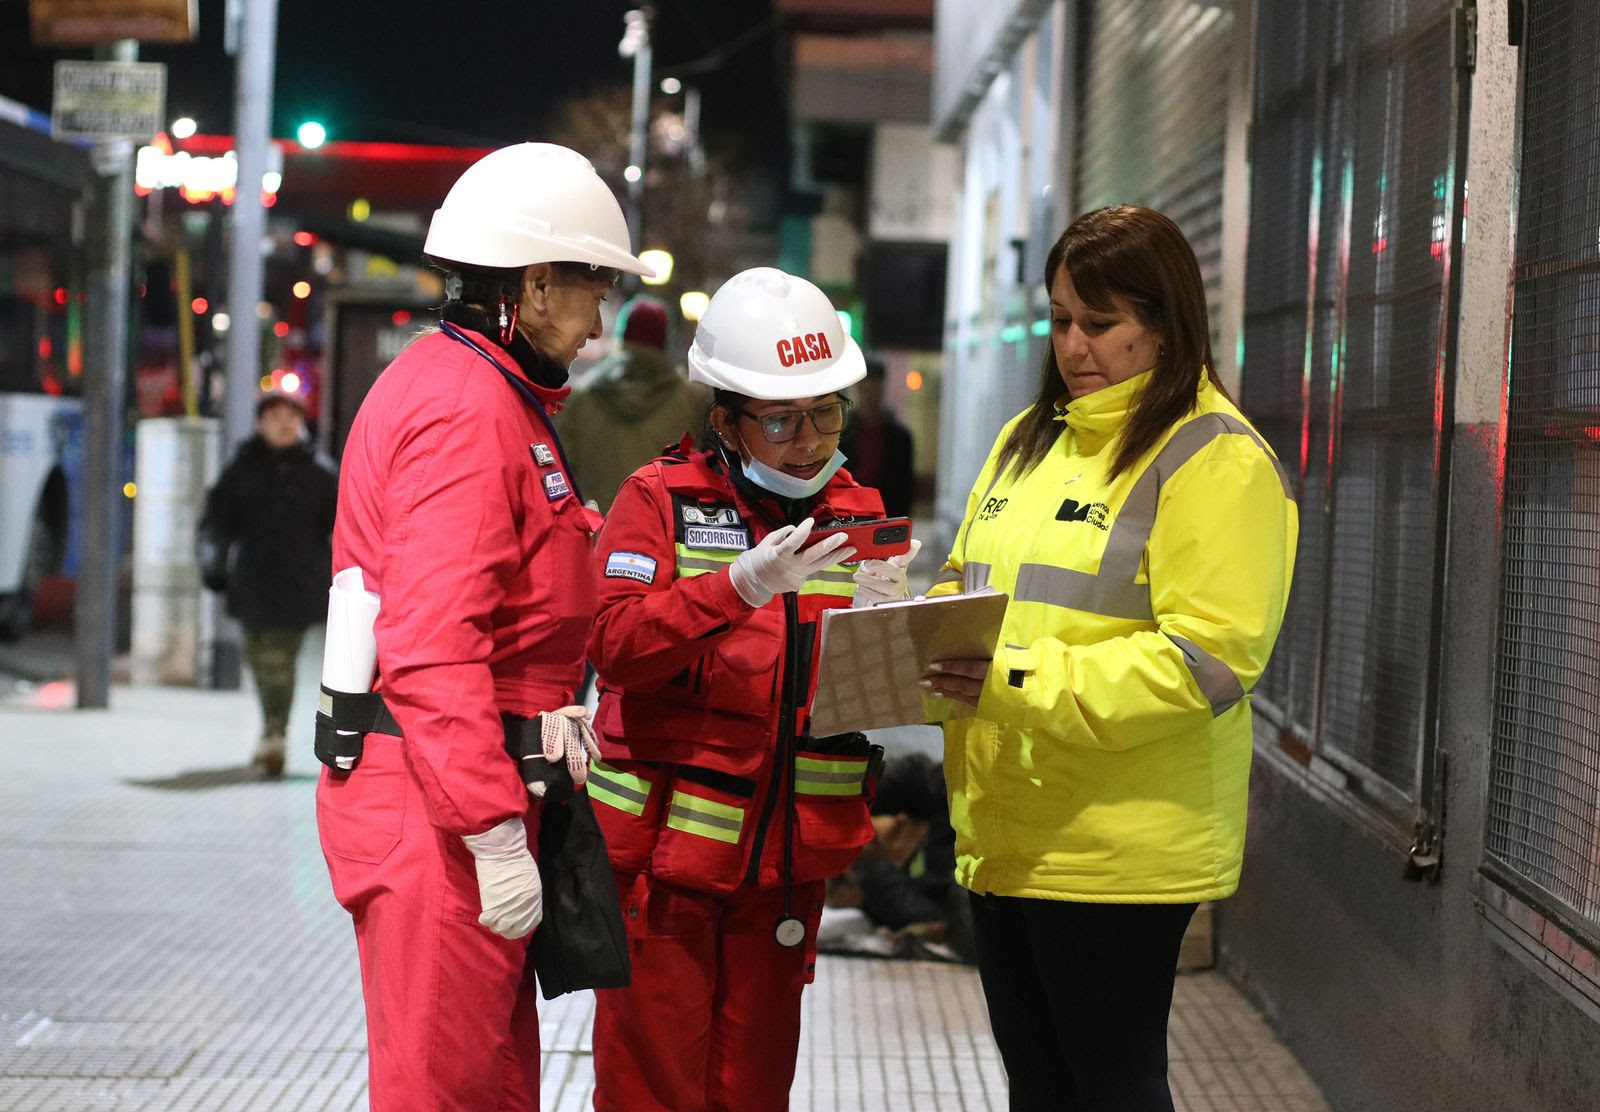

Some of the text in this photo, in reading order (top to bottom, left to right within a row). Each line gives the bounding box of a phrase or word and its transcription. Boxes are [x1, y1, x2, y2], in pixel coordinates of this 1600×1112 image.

[776, 332, 832, 367] CASA
[689, 530, 746, 546] SOCORRISTA
[607, 568, 652, 582] ARGENTINA
